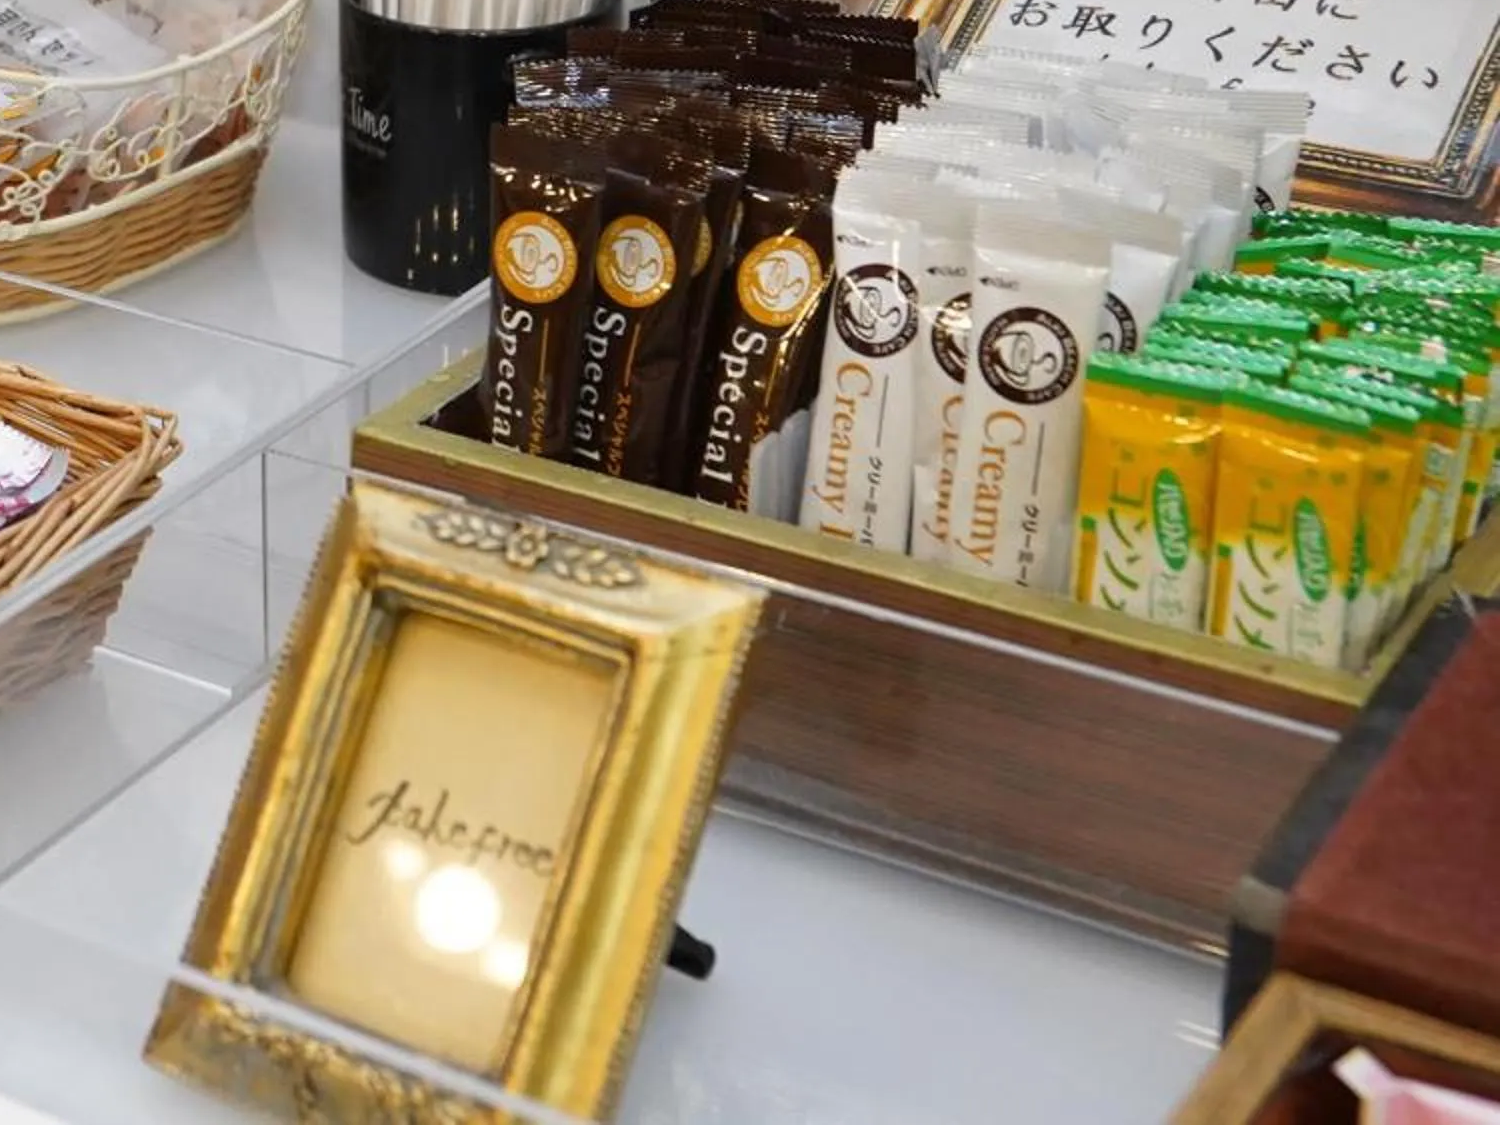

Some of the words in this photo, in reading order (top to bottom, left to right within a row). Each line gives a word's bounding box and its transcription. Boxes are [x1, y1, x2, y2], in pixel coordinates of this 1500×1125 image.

[348, 87, 393, 143] Time
[574, 307, 627, 462] Special
[812, 362, 874, 514] Creamy
[954, 411, 1028, 568] Creamy
